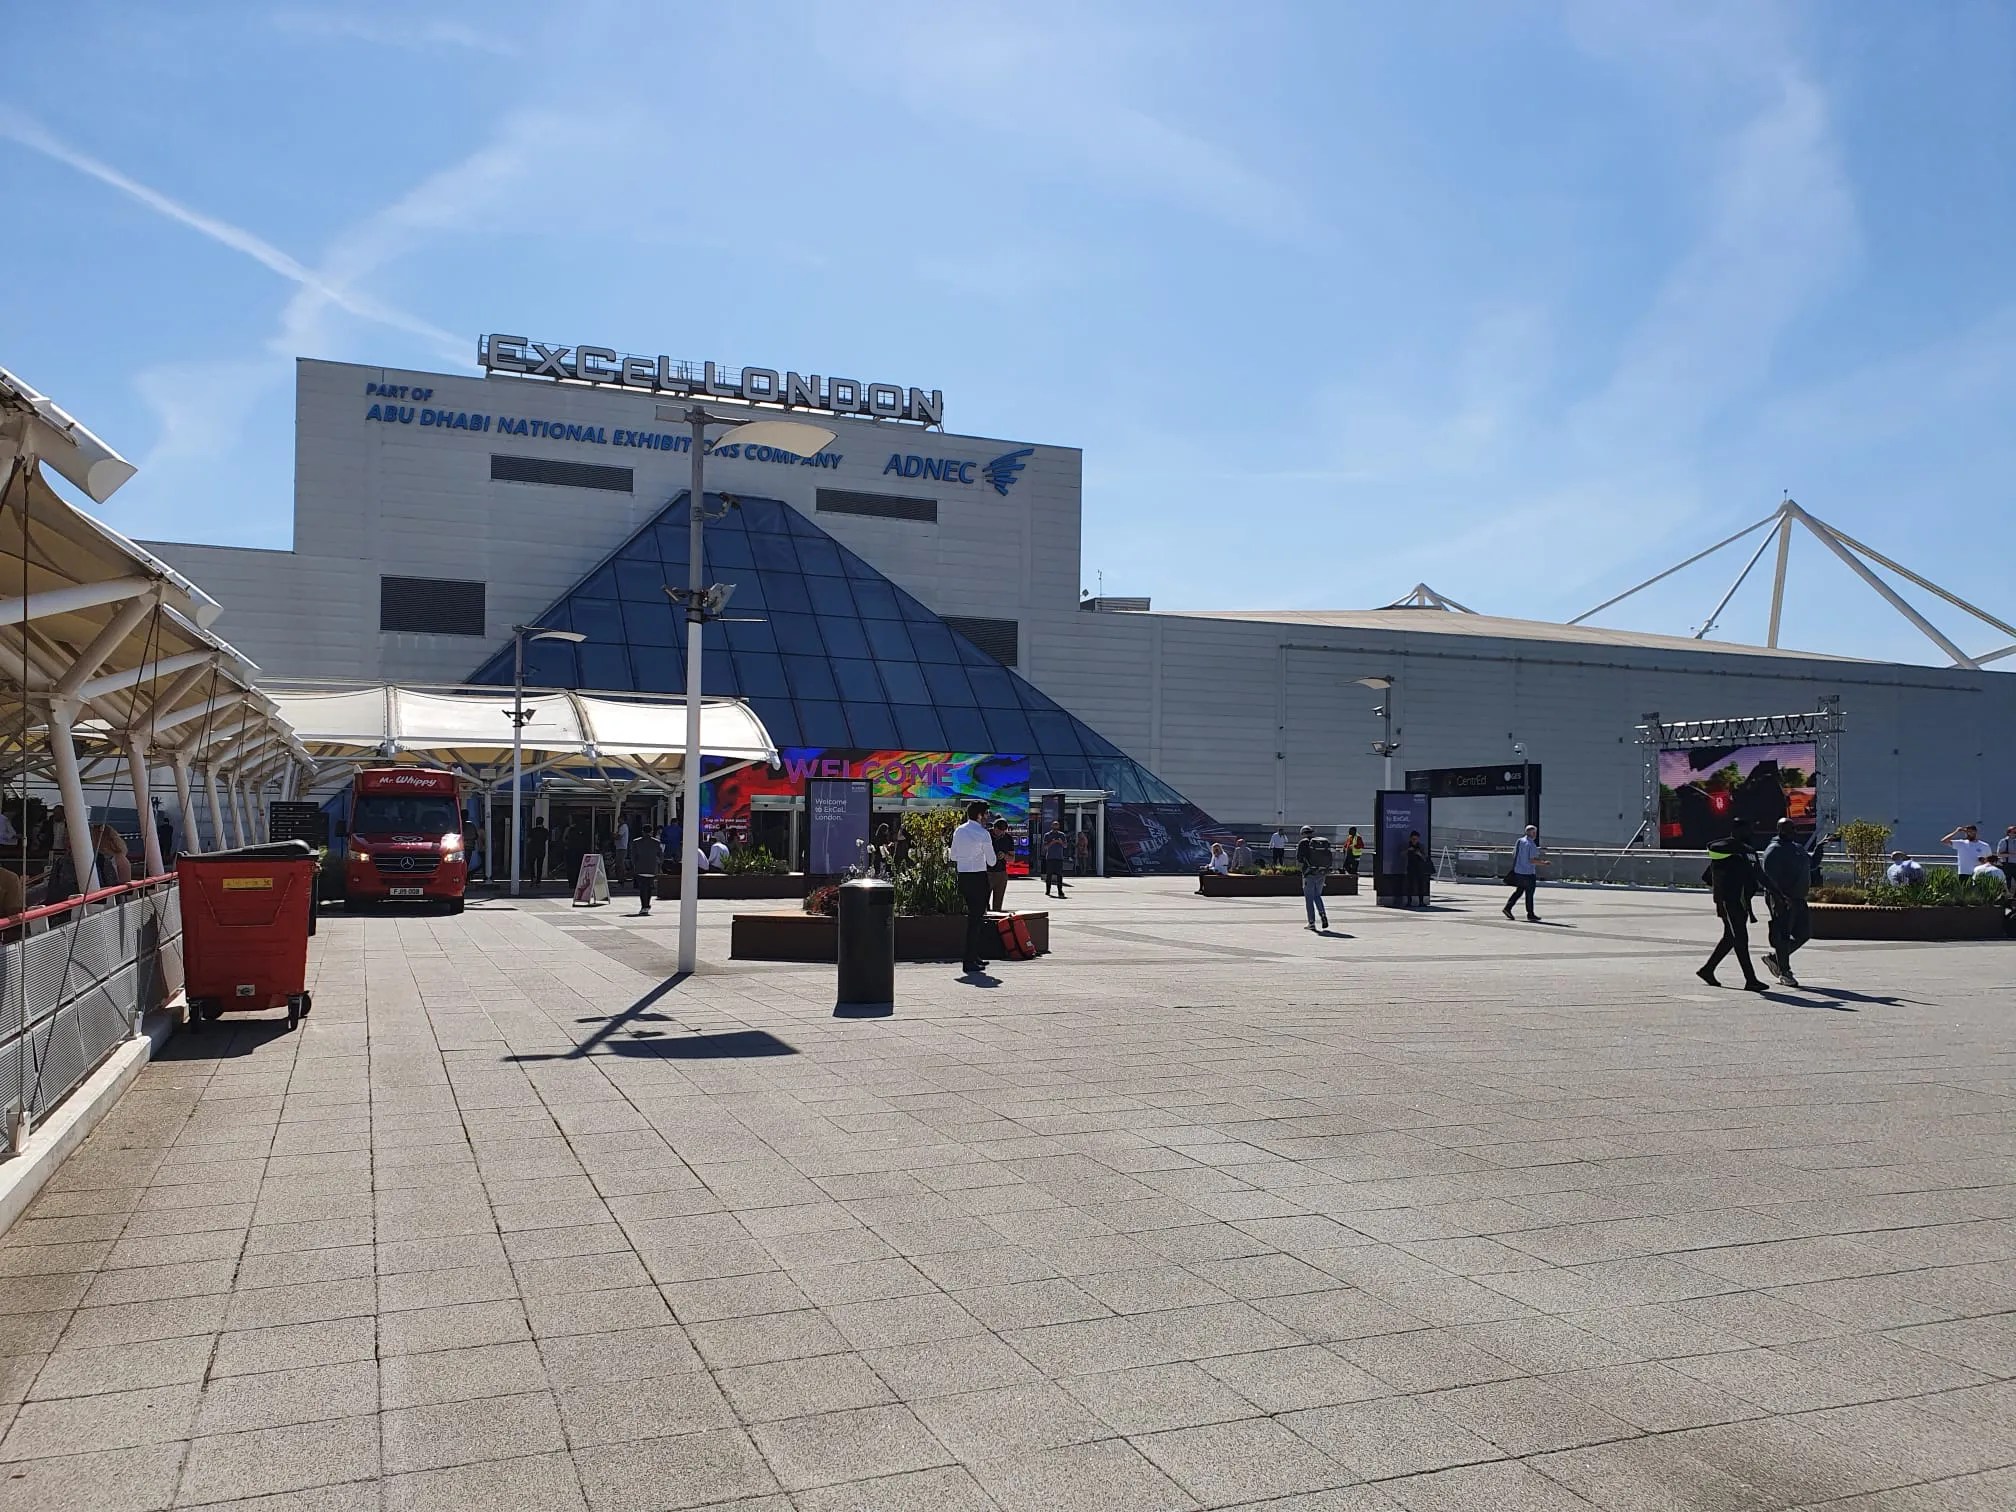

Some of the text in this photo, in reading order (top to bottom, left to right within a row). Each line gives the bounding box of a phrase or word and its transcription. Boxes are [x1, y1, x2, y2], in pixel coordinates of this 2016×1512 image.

[366, 382, 434, 401] PART OF
[704, 360, 943, 422] LONDON
[366, 404, 415, 424] ABU
[419, 408, 491, 432] DHABI
[497, 416, 608, 444] NATIONAL
[613, 429, 740, 459] EXHIBITONS
[883, 453, 977, 484] ADNEC
[395, 775, 437, 786] Whippy
[1456, 775, 1487, 786] CentrEd
